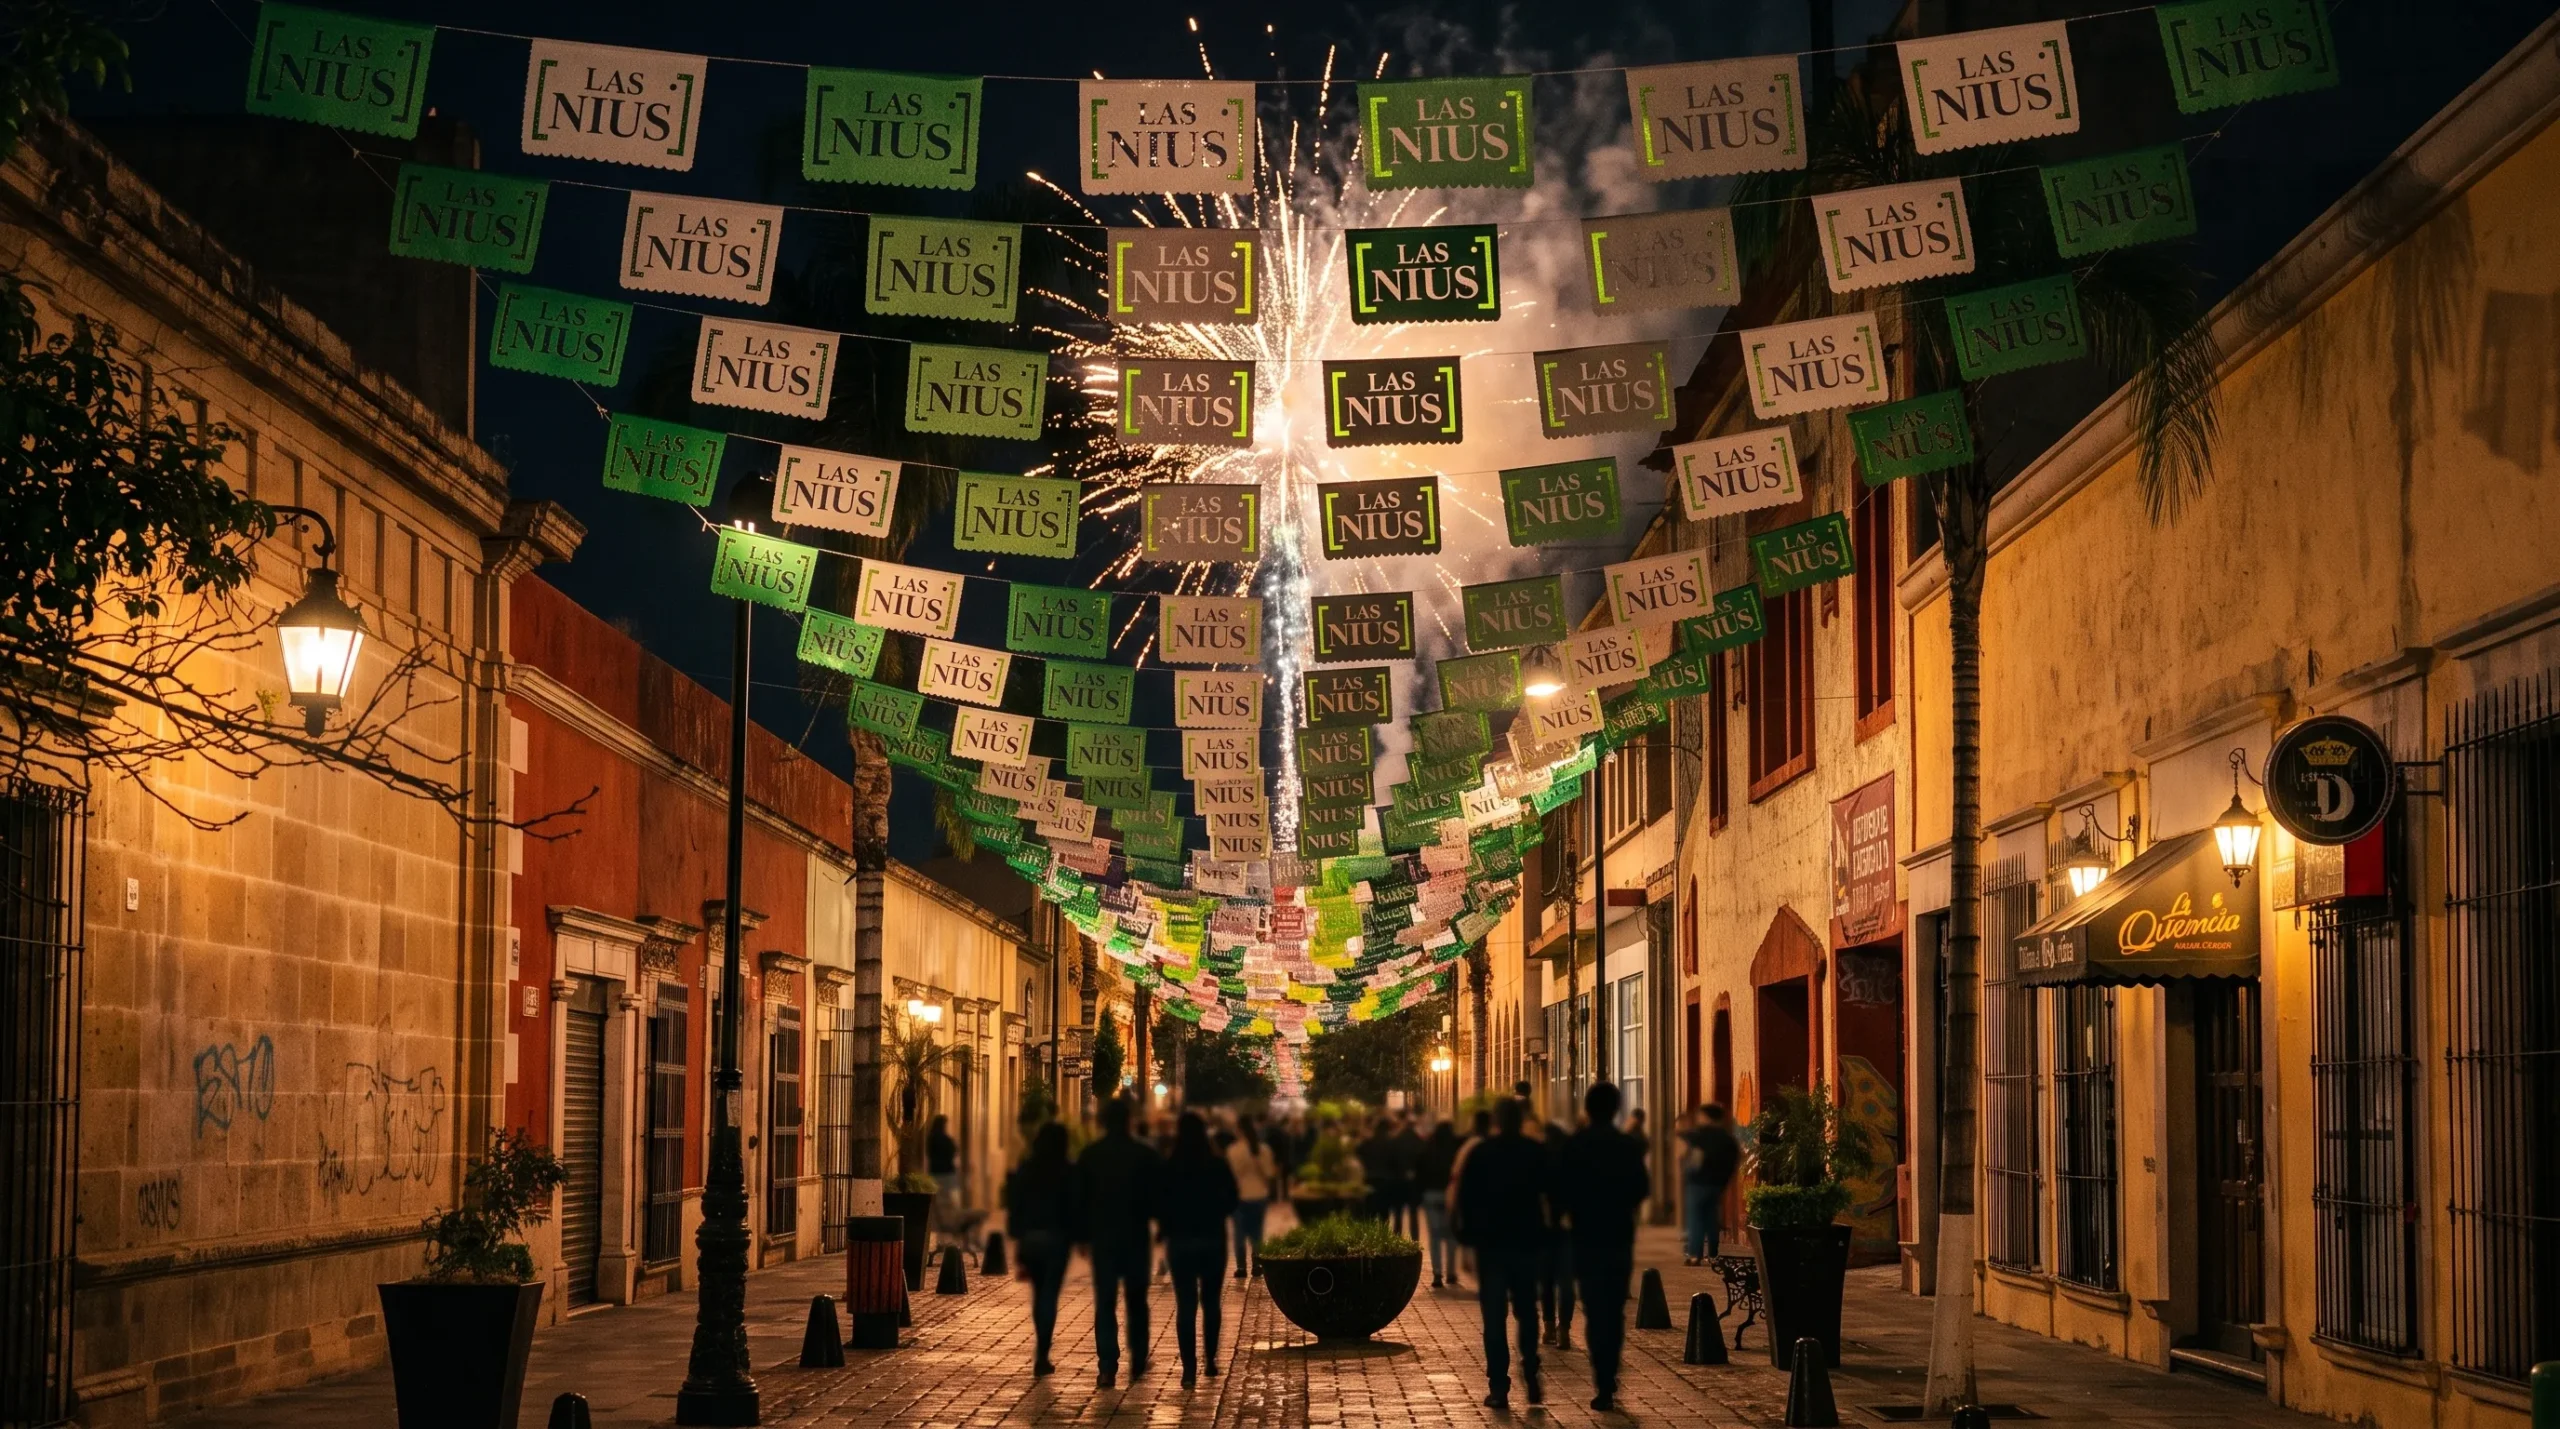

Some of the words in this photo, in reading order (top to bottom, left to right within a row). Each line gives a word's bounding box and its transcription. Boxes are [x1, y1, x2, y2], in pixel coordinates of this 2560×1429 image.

[2216, 9, 2275, 39] LAS
[313, 30, 372, 60] LAS
[2191, 30, 2312, 84] NIUS
[1956, 52, 2016, 81] LAS
[274, 53, 396, 108] NIUS
[584, 66, 644, 95] LAS
[865, 91, 923, 116] LAS
[1684, 80, 1744, 109] LAS
[1932, 75, 2053, 125] NIUS
[548, 92, 670, 141] NIUS
[1138, 101, 1197, 126] LAS
[1417, 97, 1476, 122] LAS
[829, 116, 951, 161] NIUS
[1389, 123, 1508, 163] NIUS
[1657, 108, 1780, 155] NIUS
[1107, 130, 1227, 168] NIUS
[2088, 163, 2141, 191] LAS
[444, 182, 495, 207] LAS
[2066, 183, 2174, 231] NIUS
[411, 202, 517, 247] NIUS
[677, 213, 728, 237] LAS
[1866, 202, 1918, 228] LAS
[644, 235, 751, 278] NIUS
[918, 234, 971, 257] LAS
[1158, 245, 1209, 267] LAS
[1397, 242, 1449, 263] LAS
[1842, 222, 1951, 267] NIUS
[888, 257, 995, 298] NIUS
[1370, 265, 1478, 302] NIUS
[1606, 252, 1715, 291] NIUS
[1130, 268, 1236, 303] NIUS
[540, 302, 586, 326] LAS
[1990, 294, 2034, 318] LAS
[509, 322, 605, 363] NIUS
[1972, 311, 2066, 355] NIUS
[743, 336, 790, 360] LAS
[1787, 334, 1835, 360] LAS
[715, 357, 811, 396] NIUS
[953, 361, 1001, 382] LAS
[1163, 372, 1210, 393] LAS
[1367, 370, 1416, 392] LAS
[1578, 359, 1628, 382] LAS
[1767, 356, 1866, 395] NIUS
[926, 382, 1023, 419] NIUS
[1136, 393, 1234, 429] NIUS
[1345, 391, 1444, 427] NIUS
[1557, 378, 1655, 419] NIUS
[1887, 408, 1928, 434] LAS
[645, 429, 684, 453] LAS
[1870, 423, 1958, 466] NIUS
[619, 446, 700, 487] NIUS
[1714, 447, 1756, 469] LAS
[816, 463, 859, 484] LAS
[1537, 471, 1581, 492] LAS
[1697, 464, 1782, 501] NIUS
[792, 481, 876, 517] NIUS
[996, 486, 1040, 506] LAS
[1180, 496, 1222, 516] LAS
[1357, 491, 1401, 512] LAS
[1521, 491, 1605, 526] NIUS
[973, 506, 1060, 538] NIUS
[1159, 514, 1244, 545] NIUS
[1337, 507, 1424, 542] NIUS
[1782, 528, 1816, 549] LAS
[748, 545, 782, 565] LAS
[1769, 541, 1841, 575] NIUS
[728, 560, 797, 594] NIUS
[892, 575, 928, 593] LAS
[1640, 566, 1675, 586] LAS
[870, 591, 942, 622] NIUS
[1041, 596, 1077, 613] LAS
[1495, 590, 1529, 608] LAS
[1624, 580, 1697, 614] NIUS
[1194, 608, 1229, 623] LAS
[1345, 605, 1380, 621] LAS
[1478, 605, 1552, 634] NIUS
[1694, 608, 1754, 644] NIUS
[827, 622, 856, 639] LAS
[1022, 612, 1095, 641] NIUS
[1174, 624, 1246, 649] NIUS
[1327, 621, 1400, 648] NIUS
[810, 635, 866, 664] NIUS
[1587, 637, 1616, 654] LAS
[950, 651, 981, 668] LAS
[1575, 647, 1636, 676] NIUS
[931, 665, 993, 692] NIUS
[1074, 671, 1105, 686] LAS
[1203, 681, 1234, 694] LAS
[1333, 677, 1363, 691] LAS
[872, 690, 901, 707] LAS
[1057, 685, 1120, 711] NIUS
[1188, 694, 1250, 716] NIUS
[1316, 690, 1380, 713] NIUS
[856, 702, 908, 728] NIUS
[980, 718, 1009, 733] LAS
[1540, 704, 1592, 731] NIUS
[962, 730, 1019, 756] NIUS
[1092, 733, 1121, 747] LAS
[1206, 739, 1235, 751] LAS
[1320, 732, 1348, 745] LAS
[1076, 745, 1134, 768] NIUS
[1193, 751, 1249, 771] NIUS
[1307, 745, 1363, 765] NIUS
[990, 769, 1035, 792] NIUS
[1095, 779, 1142, 799] NIUS
[1312, 779, 1364, 799] NIUS
[1205, 787, 1254, 804] NIUS
[1405, 793, 1452, 811] NIUS
[1215, 813, 1260, 827] NIUS
[1219, 837, 1262, 853] NIUS
[1307, 832, 1350, 850] NIUS
